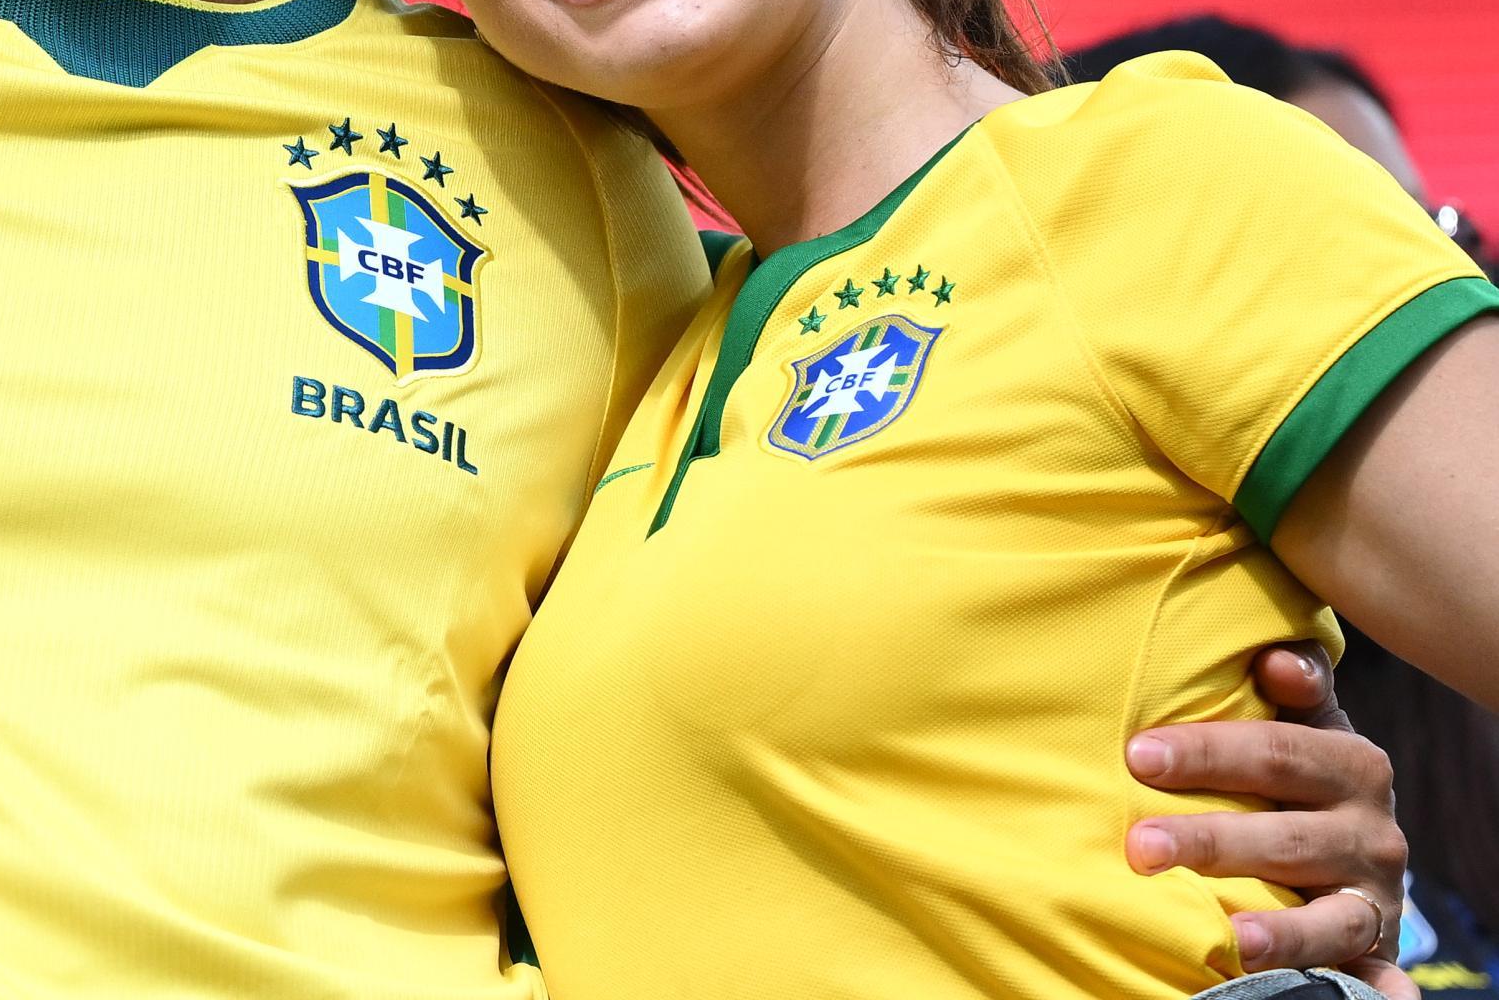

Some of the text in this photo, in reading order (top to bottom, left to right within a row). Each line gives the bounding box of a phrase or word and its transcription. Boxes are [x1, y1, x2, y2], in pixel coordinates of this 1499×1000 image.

[357, 249, 426, 285] CBF
[824, 371, 876, 394] CBF
[290, 375, 479, 476] BRASIL
